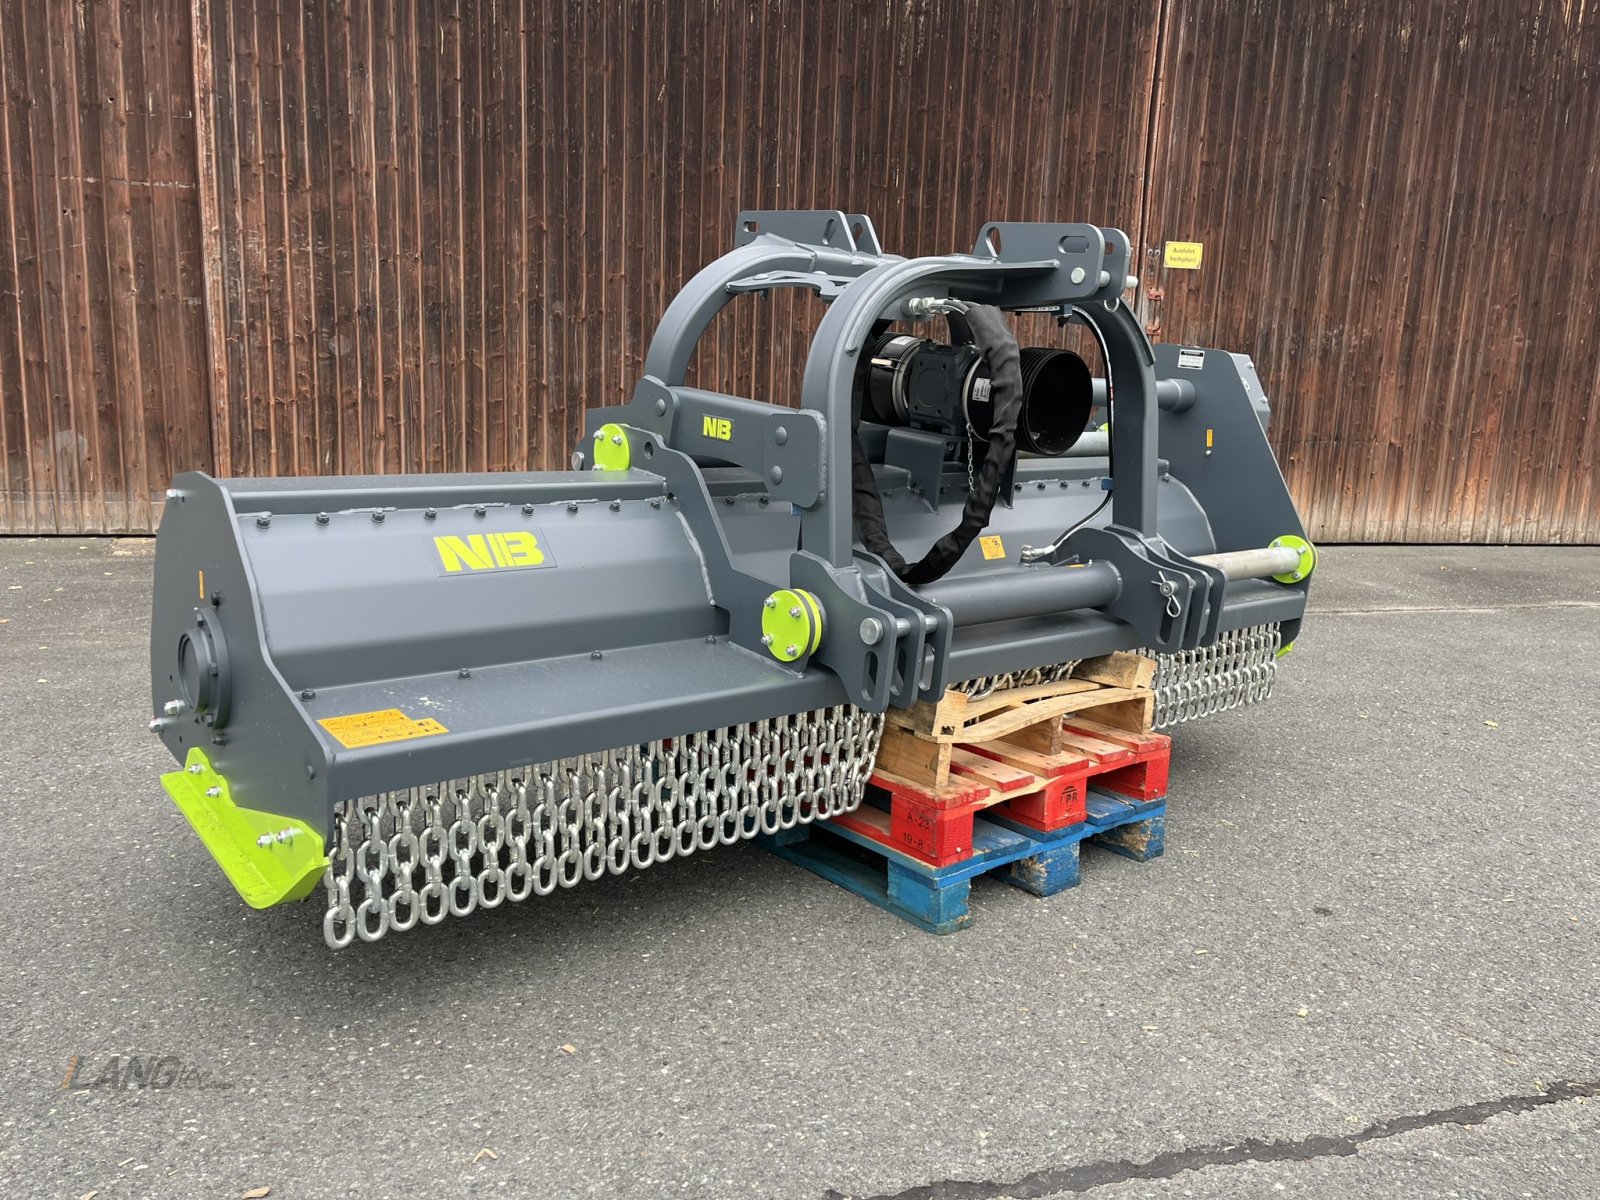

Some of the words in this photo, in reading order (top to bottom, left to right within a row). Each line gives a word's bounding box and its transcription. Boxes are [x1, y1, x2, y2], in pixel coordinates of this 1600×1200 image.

[1172, 247, 1196, 255] Ausfahrt
[703, 416, 732, 441] NB
[433, 531, 545, 572] NB
